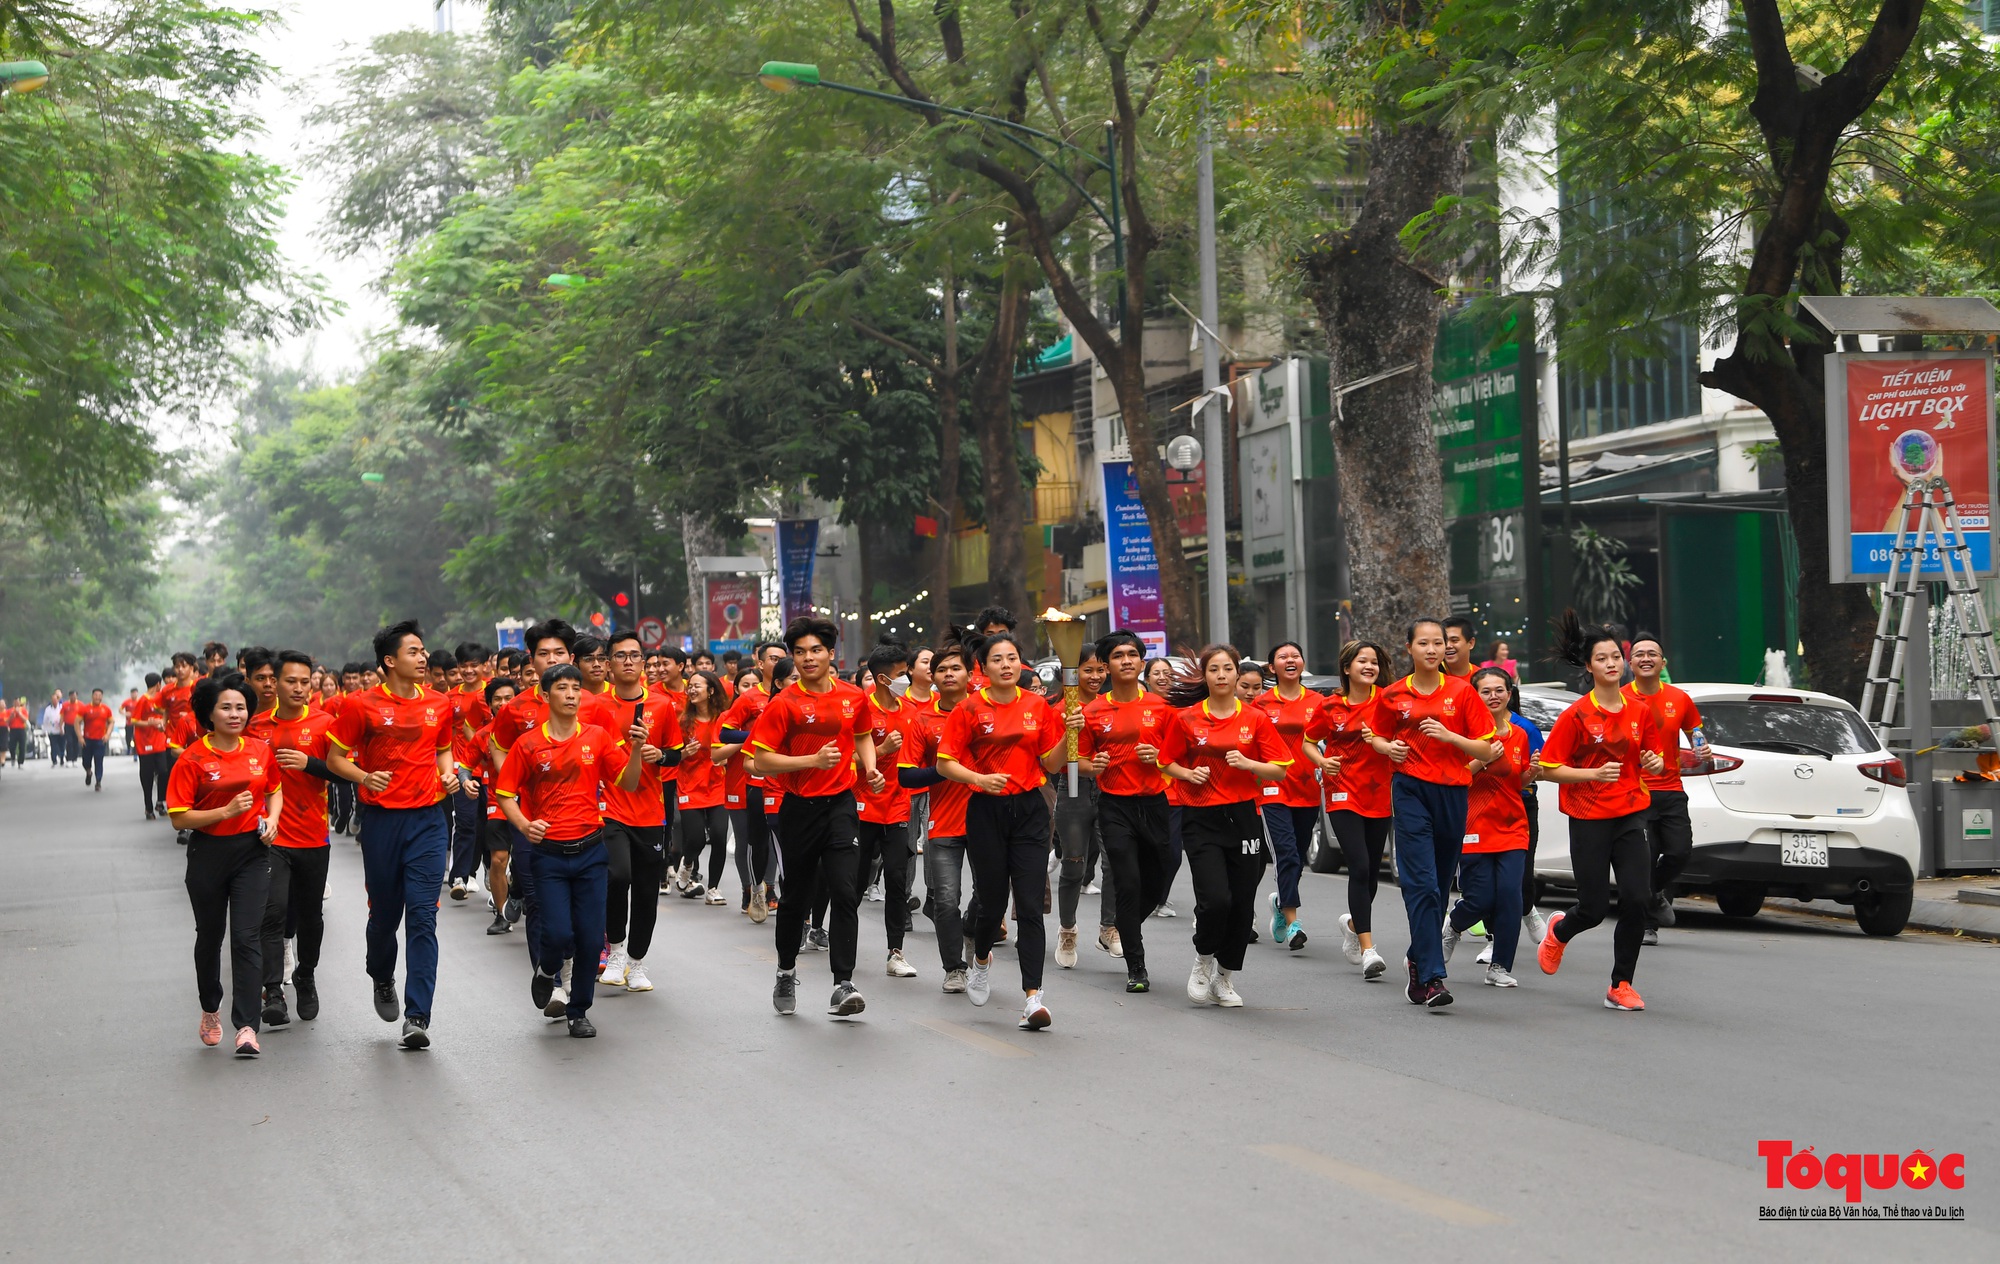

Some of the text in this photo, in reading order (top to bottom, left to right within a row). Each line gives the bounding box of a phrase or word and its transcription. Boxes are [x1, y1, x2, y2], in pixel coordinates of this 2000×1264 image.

[1881, 368, 1952, 388] TIẾT KIỆM
[1474, 373, 1492, 407] Việt
[1493, 371, 1516, 397] Nam
[1867, 383, 1967, 401] CHI PHÍ QUẢNG CÁO VỚI
[1859, 395, 1969, 421] LIGHT BOX
[1491, 515, 1514, 563] 36
[1130, 554, 1151, 562] GAMES
[1123, 586, 1158, 597] Cambodia
[1792, 834, 1817, 850] 30E
[1783, 849, 1827, 866] 243.68
